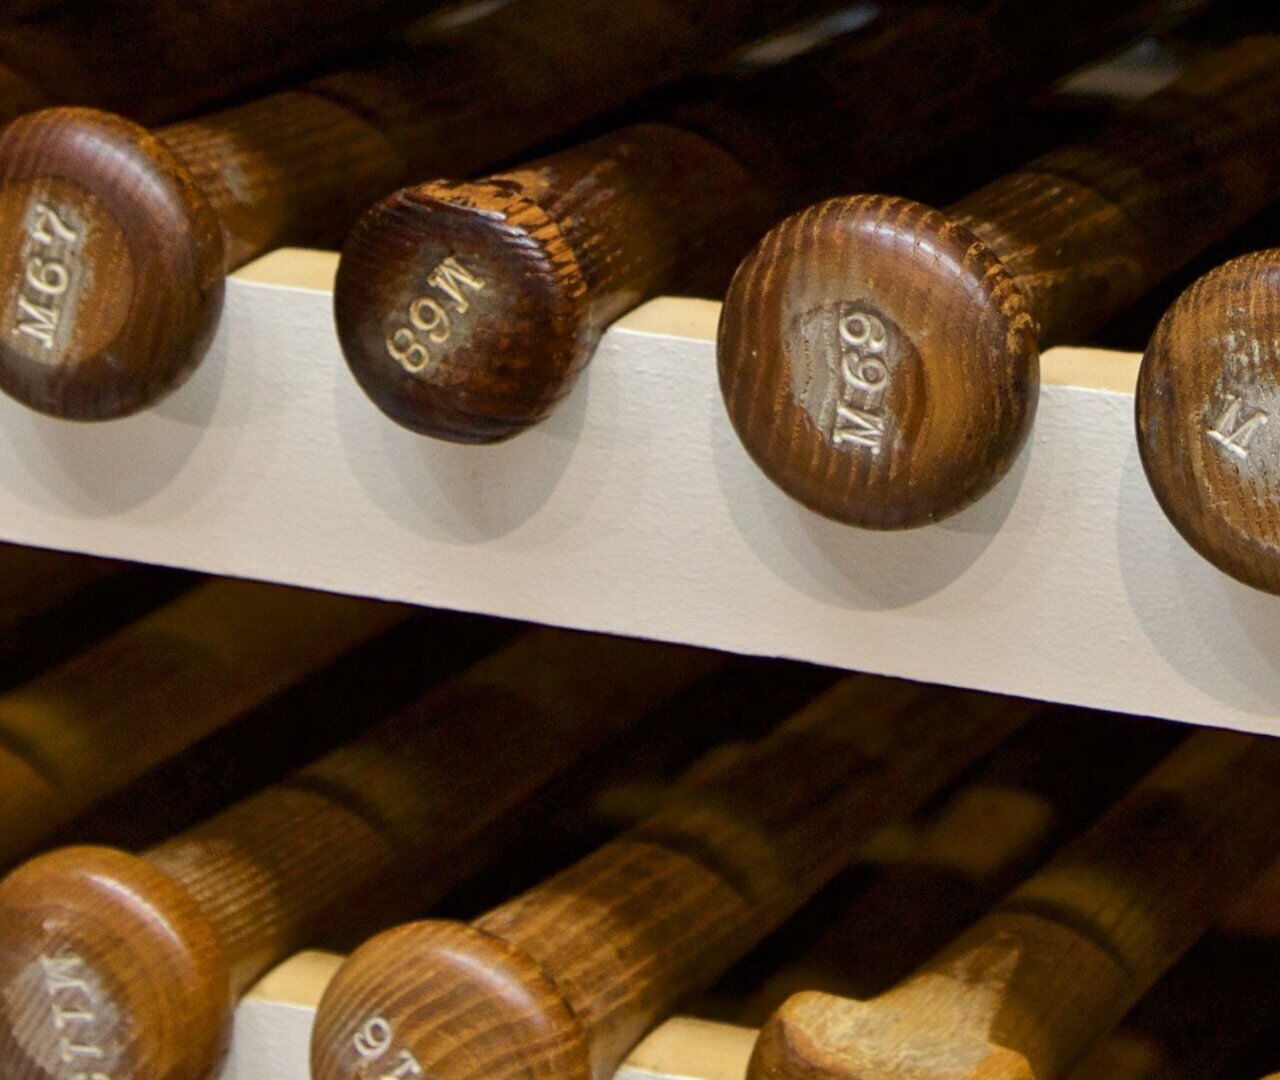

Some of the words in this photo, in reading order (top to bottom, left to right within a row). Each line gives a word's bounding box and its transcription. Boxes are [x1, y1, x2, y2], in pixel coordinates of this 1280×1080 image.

[12, 205, 78, 350] M67
[384, 257, 486, 375] M68
[832, 311, 889, 456] M69
[41, 948, 112, 1080] M11
